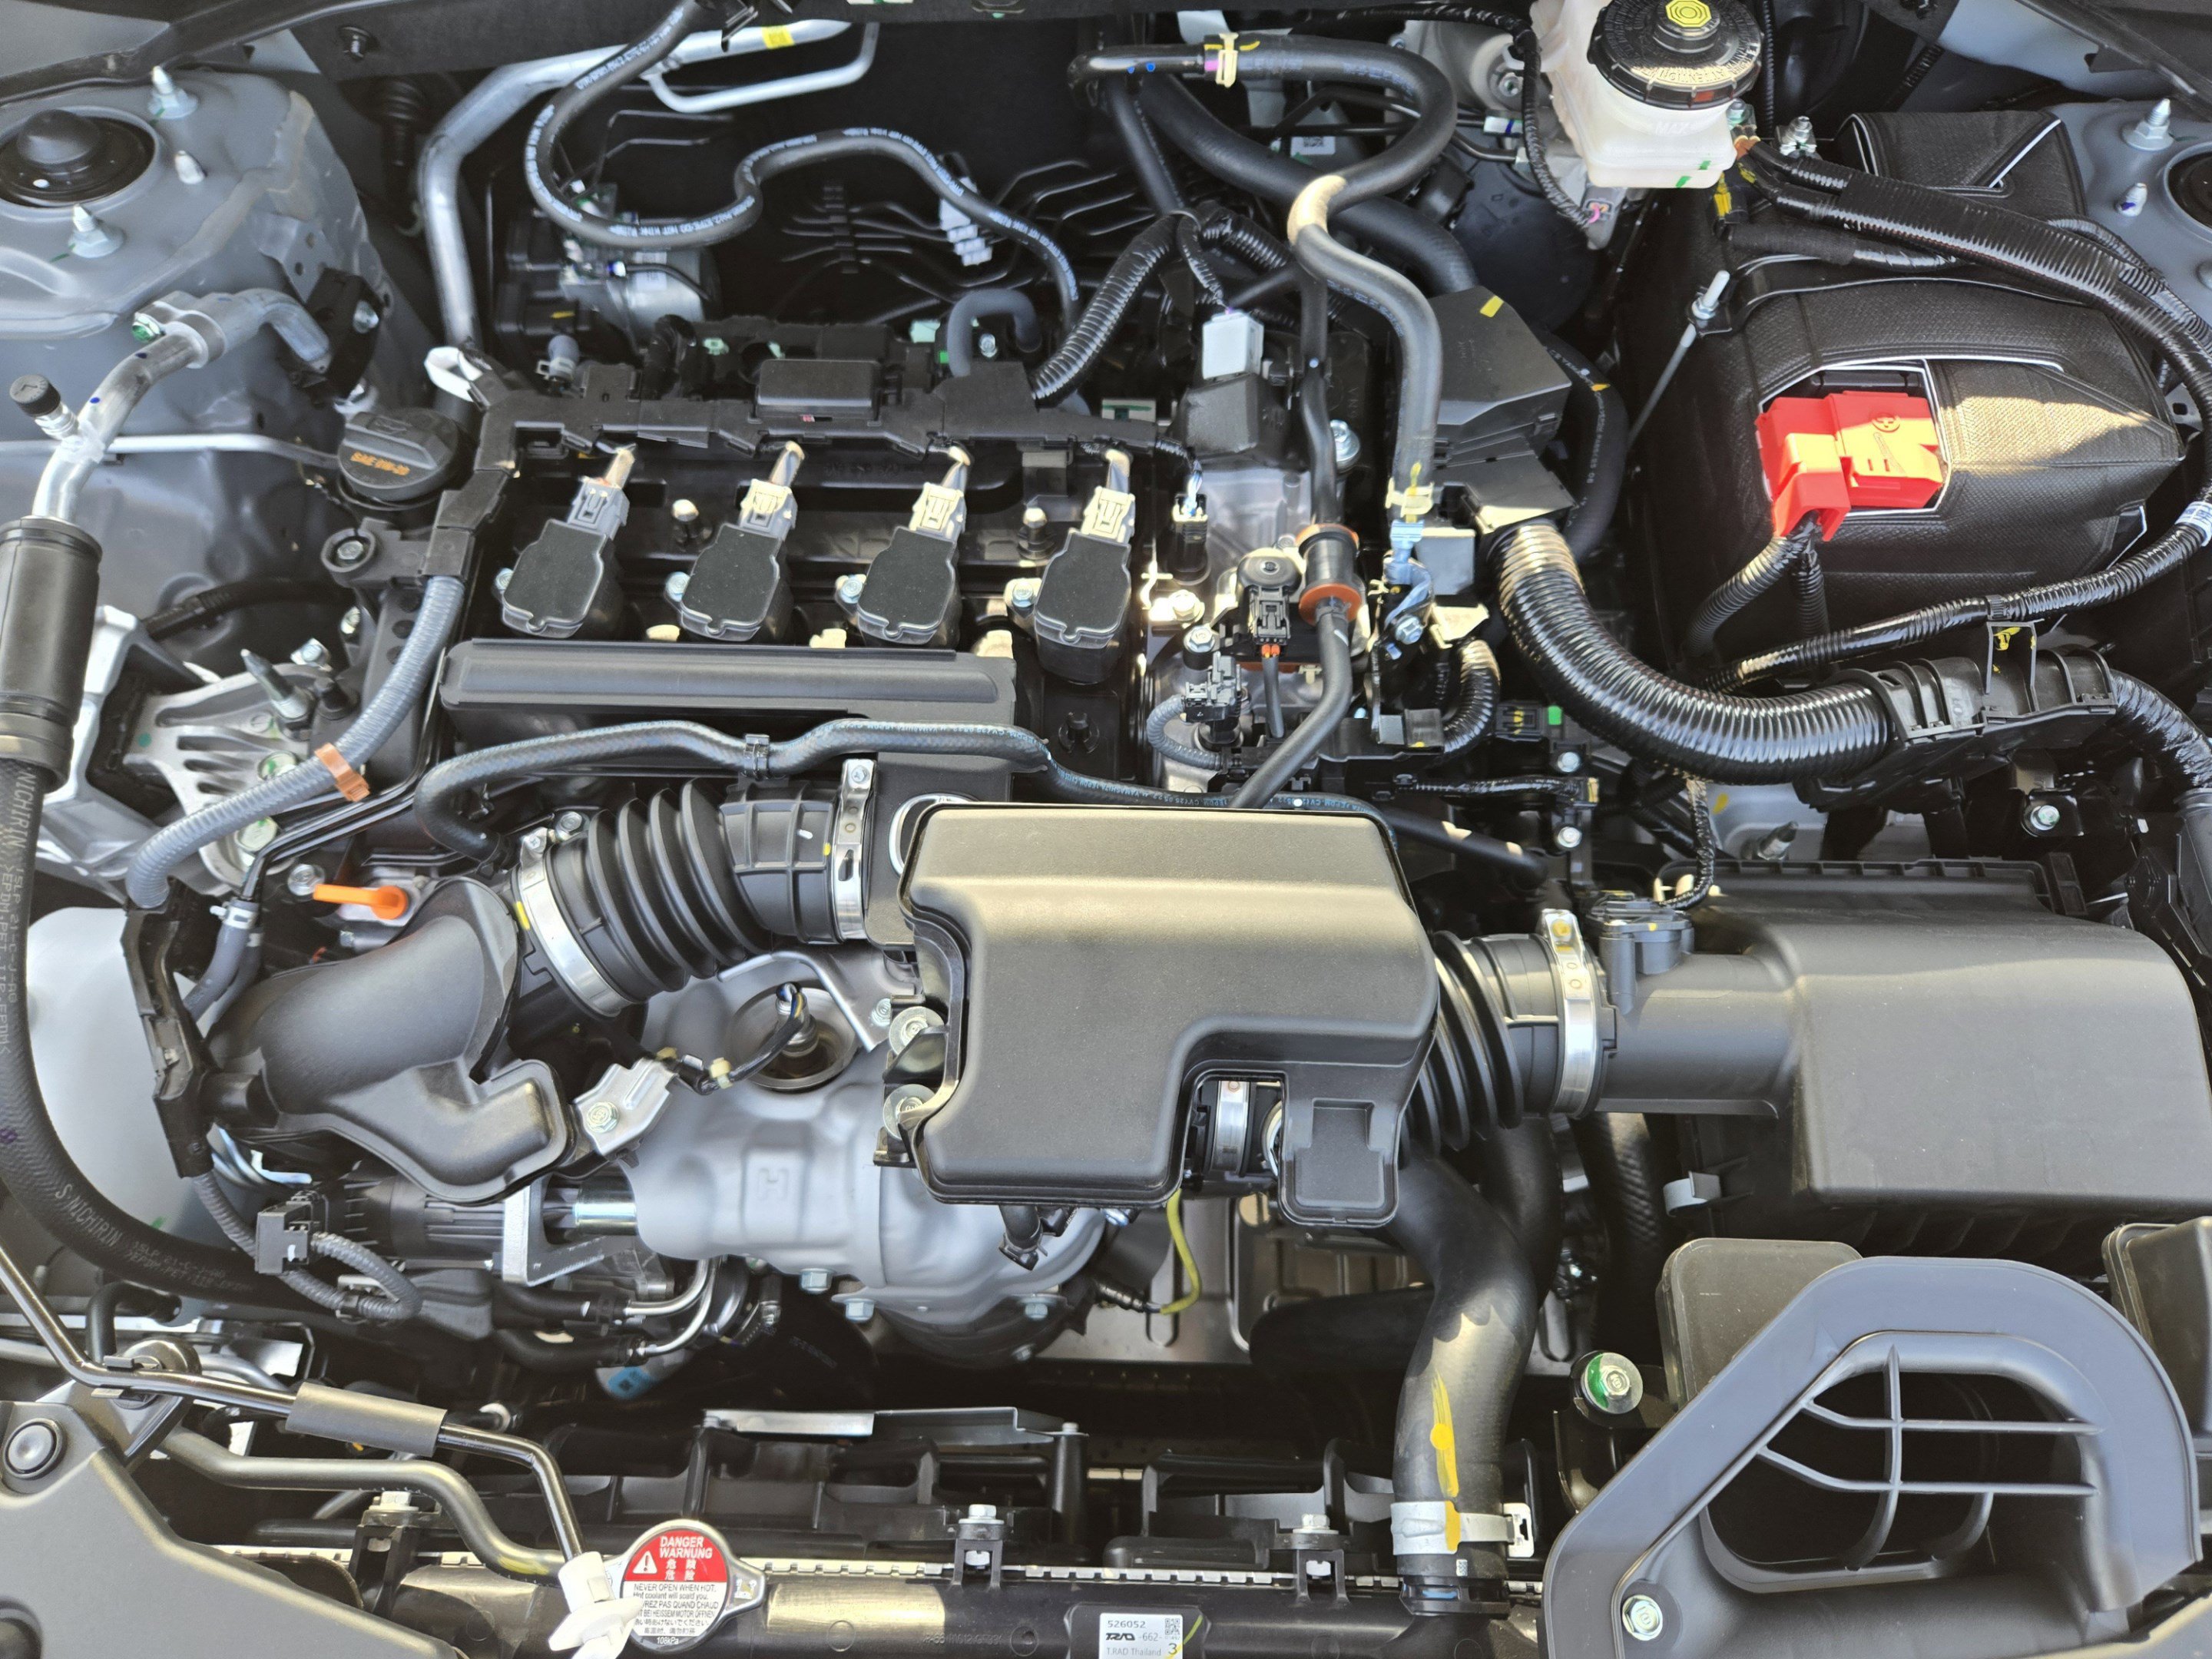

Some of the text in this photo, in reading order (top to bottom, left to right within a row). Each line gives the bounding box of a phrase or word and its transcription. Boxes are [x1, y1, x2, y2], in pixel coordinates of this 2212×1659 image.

[1655, 121, 1689, 135] MAX
[9, 771, 36, 848] NICHIRIN
[660, 1536, 704, 1548] DANGER
[659, 1548, 713, 1558] WARNUNG
[1108, 1620, 1146, 1628] 526052
[657, 1637, 679, 1645] 108kPa
[1139, 1633, 1163, 1641] -662-
[1131, 1647, 1161, 1656] Thailand
[1168, 1643, 1177, 1655] 3
